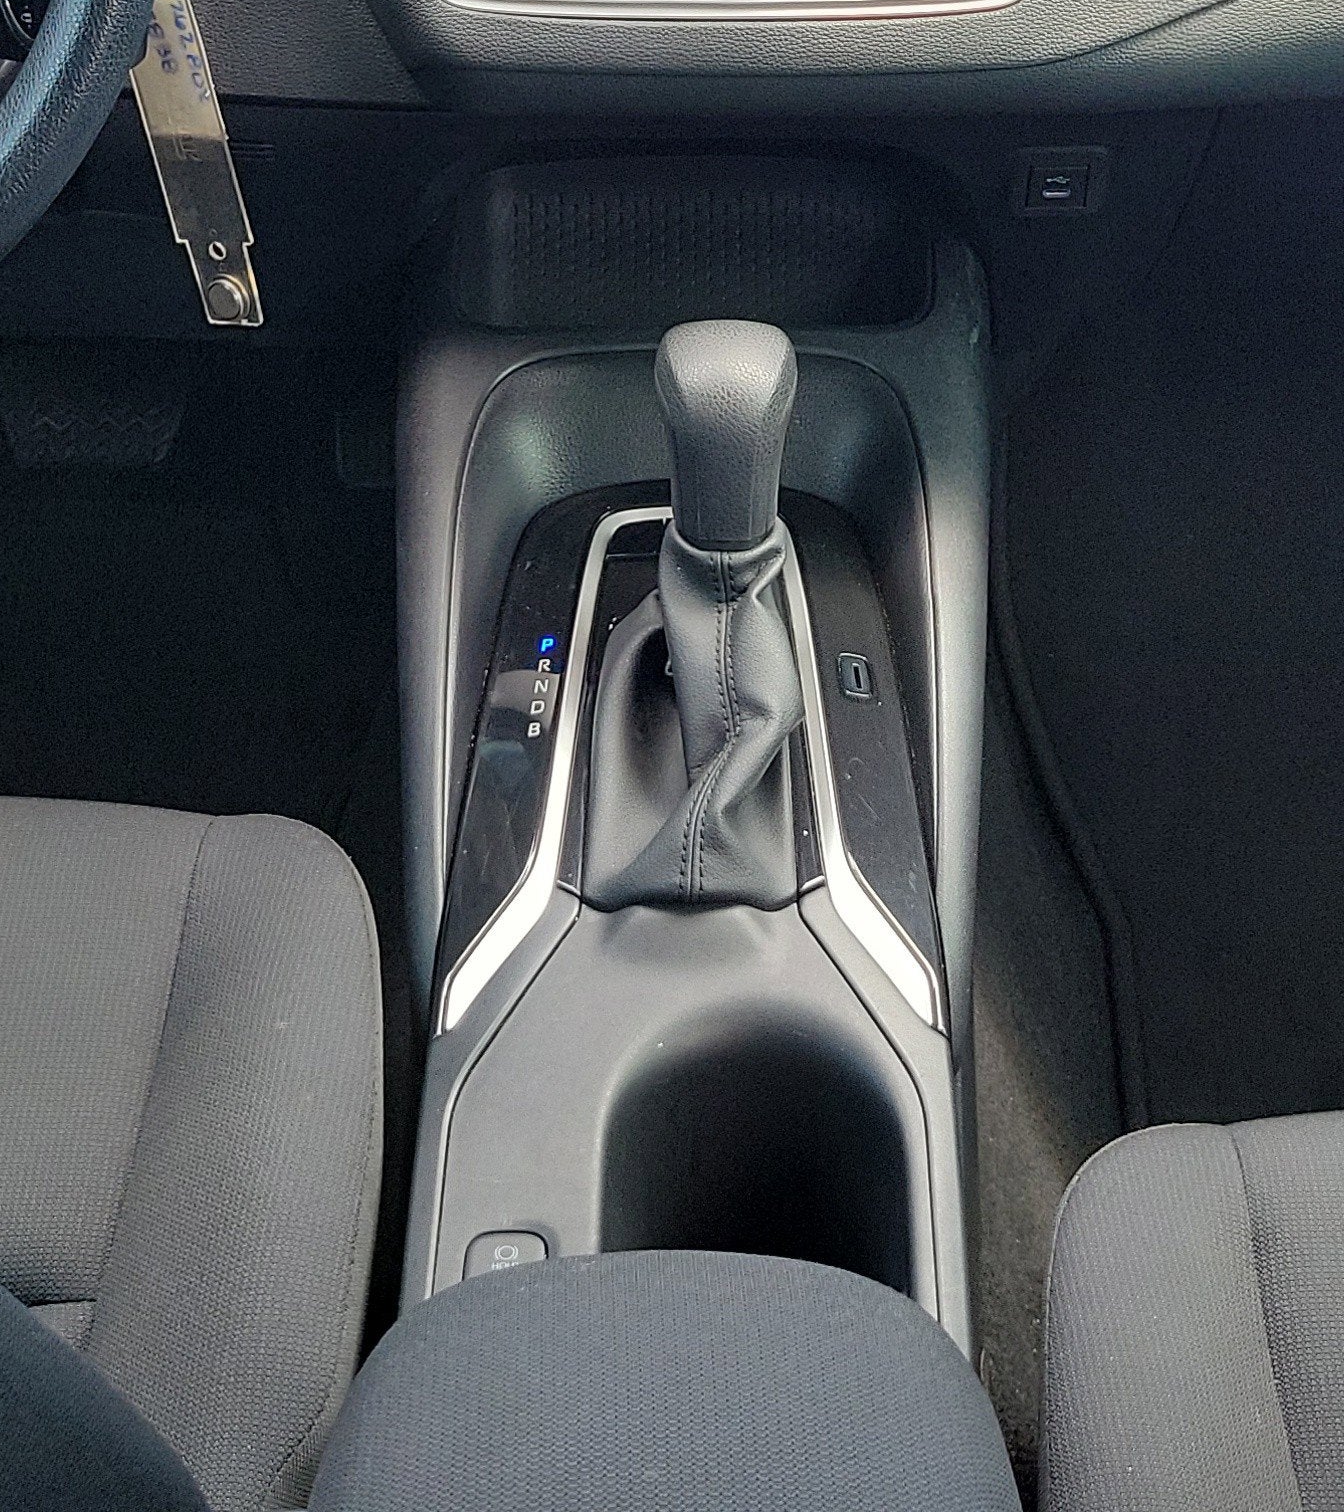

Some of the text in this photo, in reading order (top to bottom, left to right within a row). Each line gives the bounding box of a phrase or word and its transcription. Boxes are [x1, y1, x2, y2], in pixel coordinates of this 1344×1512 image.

[540, 637, 554, 652] P
[537, 658, 551, 673] R
[533, 678, 549, 694] N
[530, 699, 545, 715] D
[527, 721, 541, 738] B
